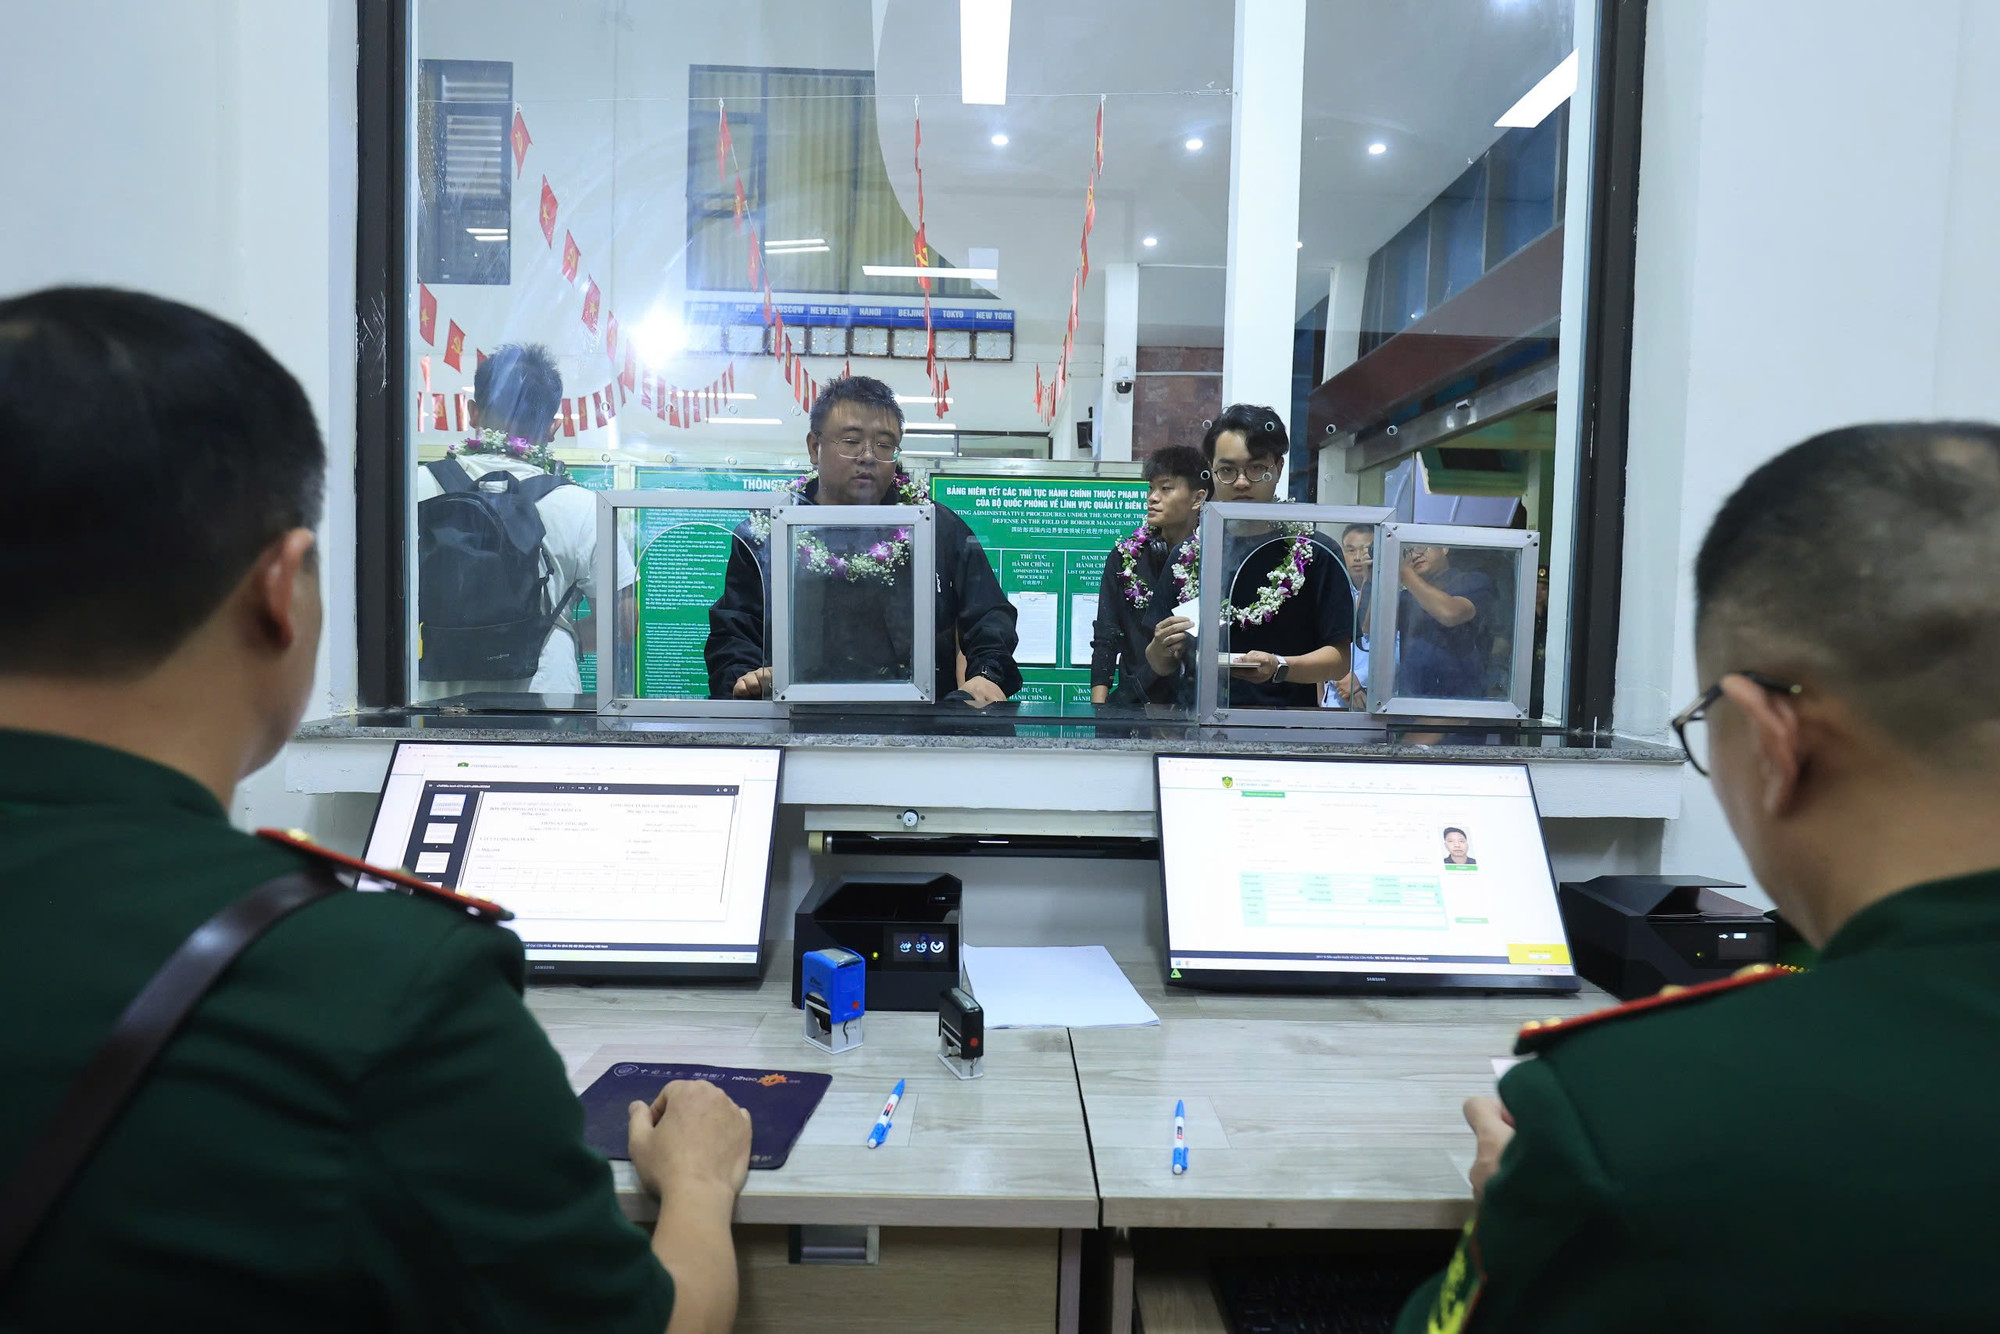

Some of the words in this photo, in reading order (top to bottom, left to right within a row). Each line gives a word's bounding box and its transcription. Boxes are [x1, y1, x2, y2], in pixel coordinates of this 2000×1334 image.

[810, 306, 827, 315] NEW
[828, 306, 849, 315] DELHI
[859, 307, 882, 317] HANOI
[942, 310, 964, 319] TOKYO
[976, 311, 992, 320] NEW
[994, 311, 1013, 321] YORK
[946, 485, 966, 496] BẢNG
[967, 486, 987, 496] NIÊM
[988, 485, 1001, 497] YẾT
[1002, 486, 1017, 497] CÁC
[1018, 486, 1032, 497] THỦ
[1033, 488, 1047, 498] TỤC
[1048, 488, 1068, 498] HÀNH
[1069, 488, 1092, 498] CHÍNH
[1093, 489, 1116, 500] THUỘC
[1118, 490, 1139, 500] PHẠM
[976, 497, 990, 507] CỦA
[992, 498, 1001, 508] BỘ
[1003, 497, 1023, 508] QUỐC
[1024, 498, 1048, 508] PHÒNG
[1078, 500, 1092, 511] VỰC
[1093, 499, 1113, 510] QUẢN
[1115, 500, 1123, 510] LÝ
[1125, 500, 1142, 510] BIÊN
[1020, 552, 1033, 560] THỦ
